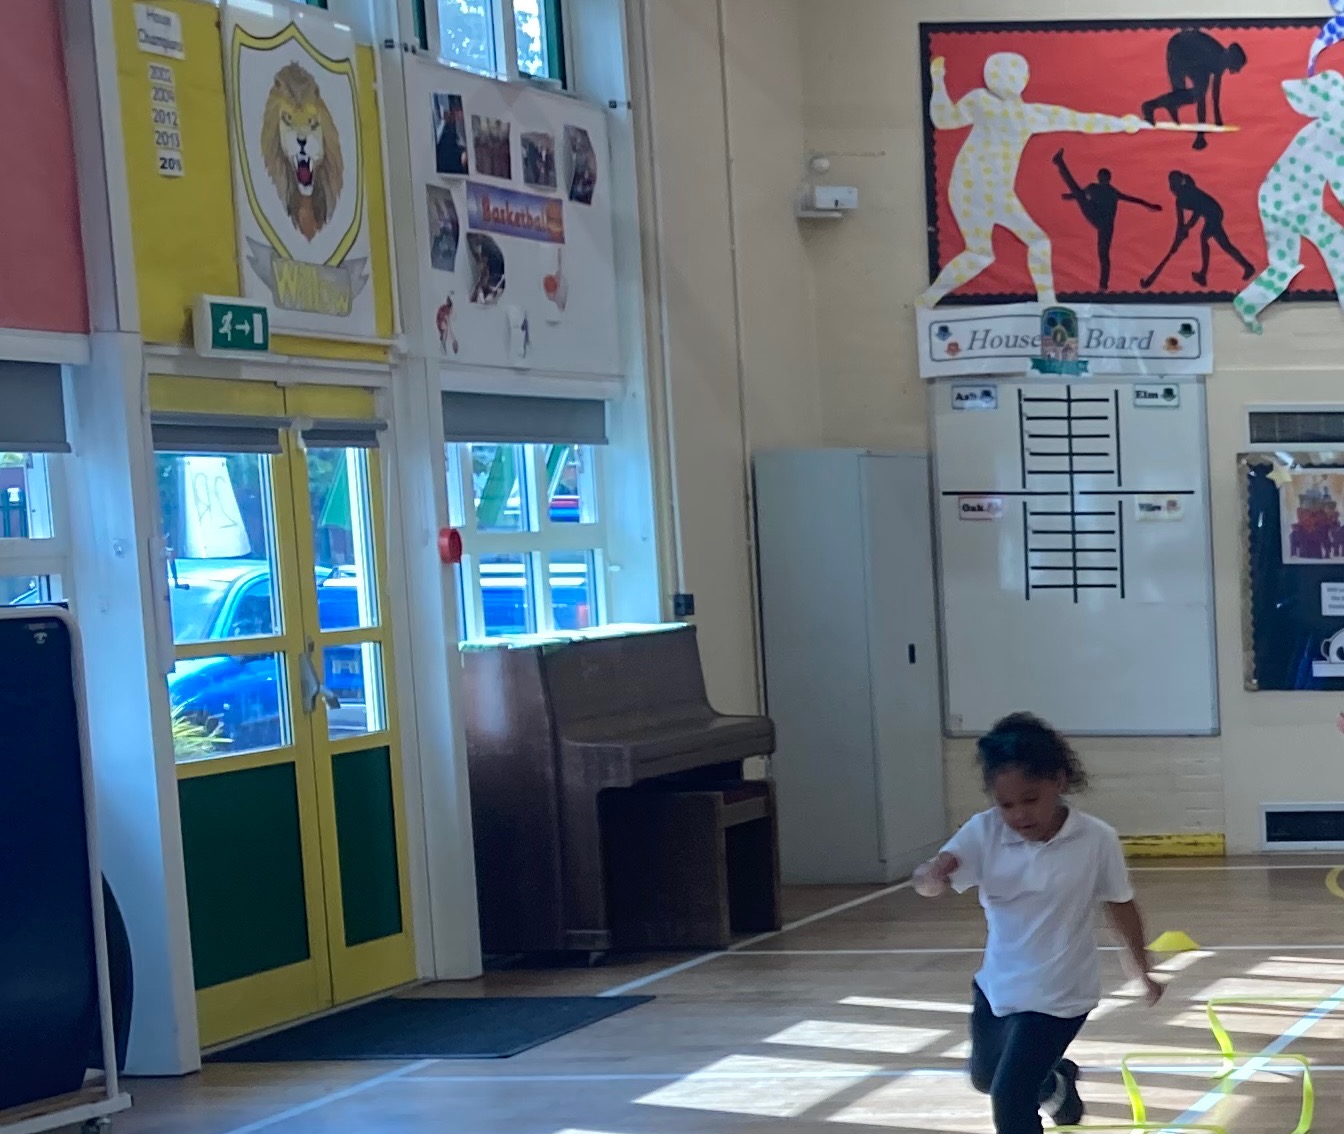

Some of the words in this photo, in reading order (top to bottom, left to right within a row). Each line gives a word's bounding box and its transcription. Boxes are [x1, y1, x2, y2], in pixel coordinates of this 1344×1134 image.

[966, 328, 1041, 352] House
[1085, 326, 1156, 352] Board
[1135, 389, 1160, 400] Elm
[961, 502, 985, 513] Oak
